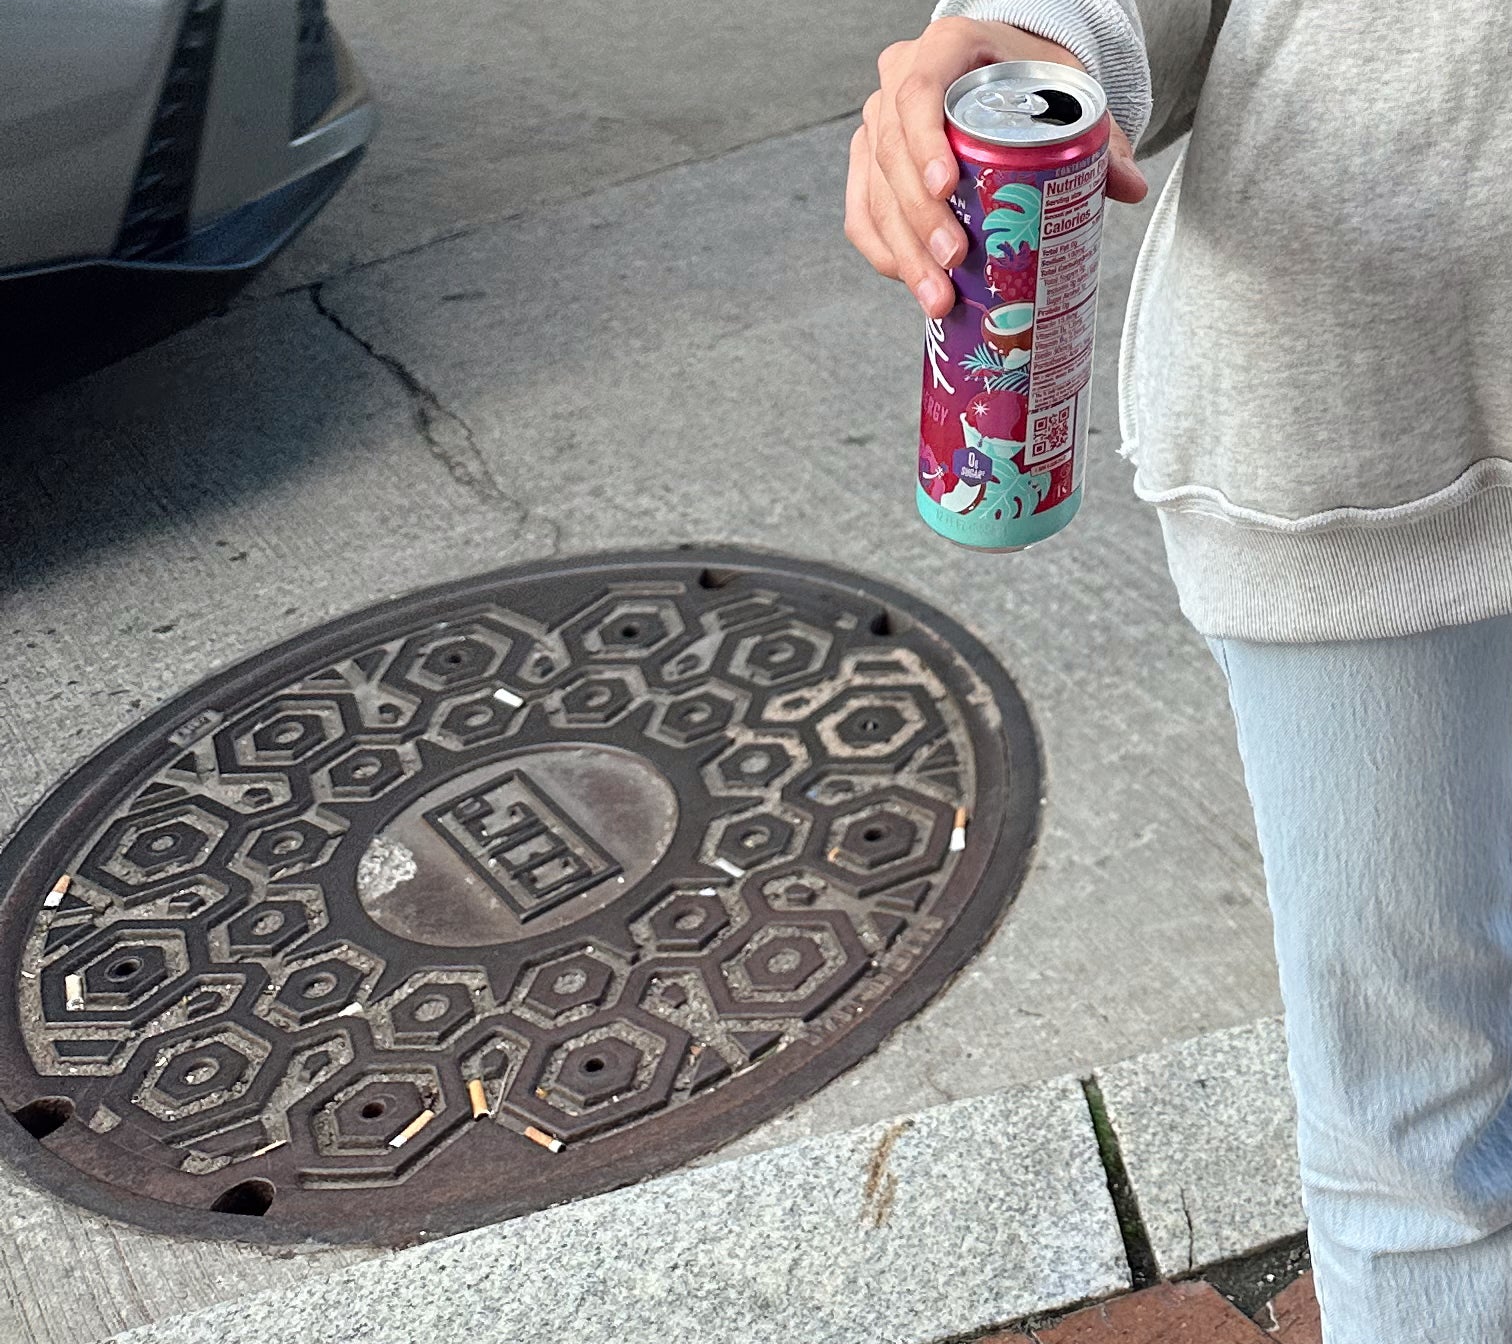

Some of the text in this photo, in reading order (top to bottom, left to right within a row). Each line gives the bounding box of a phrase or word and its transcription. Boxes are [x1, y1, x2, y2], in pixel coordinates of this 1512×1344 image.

[1046, 168, 1096, 197] Nutrition
[1044, 208, 1091, 235] Calories
[923, 390, 949, 427] ERGY
